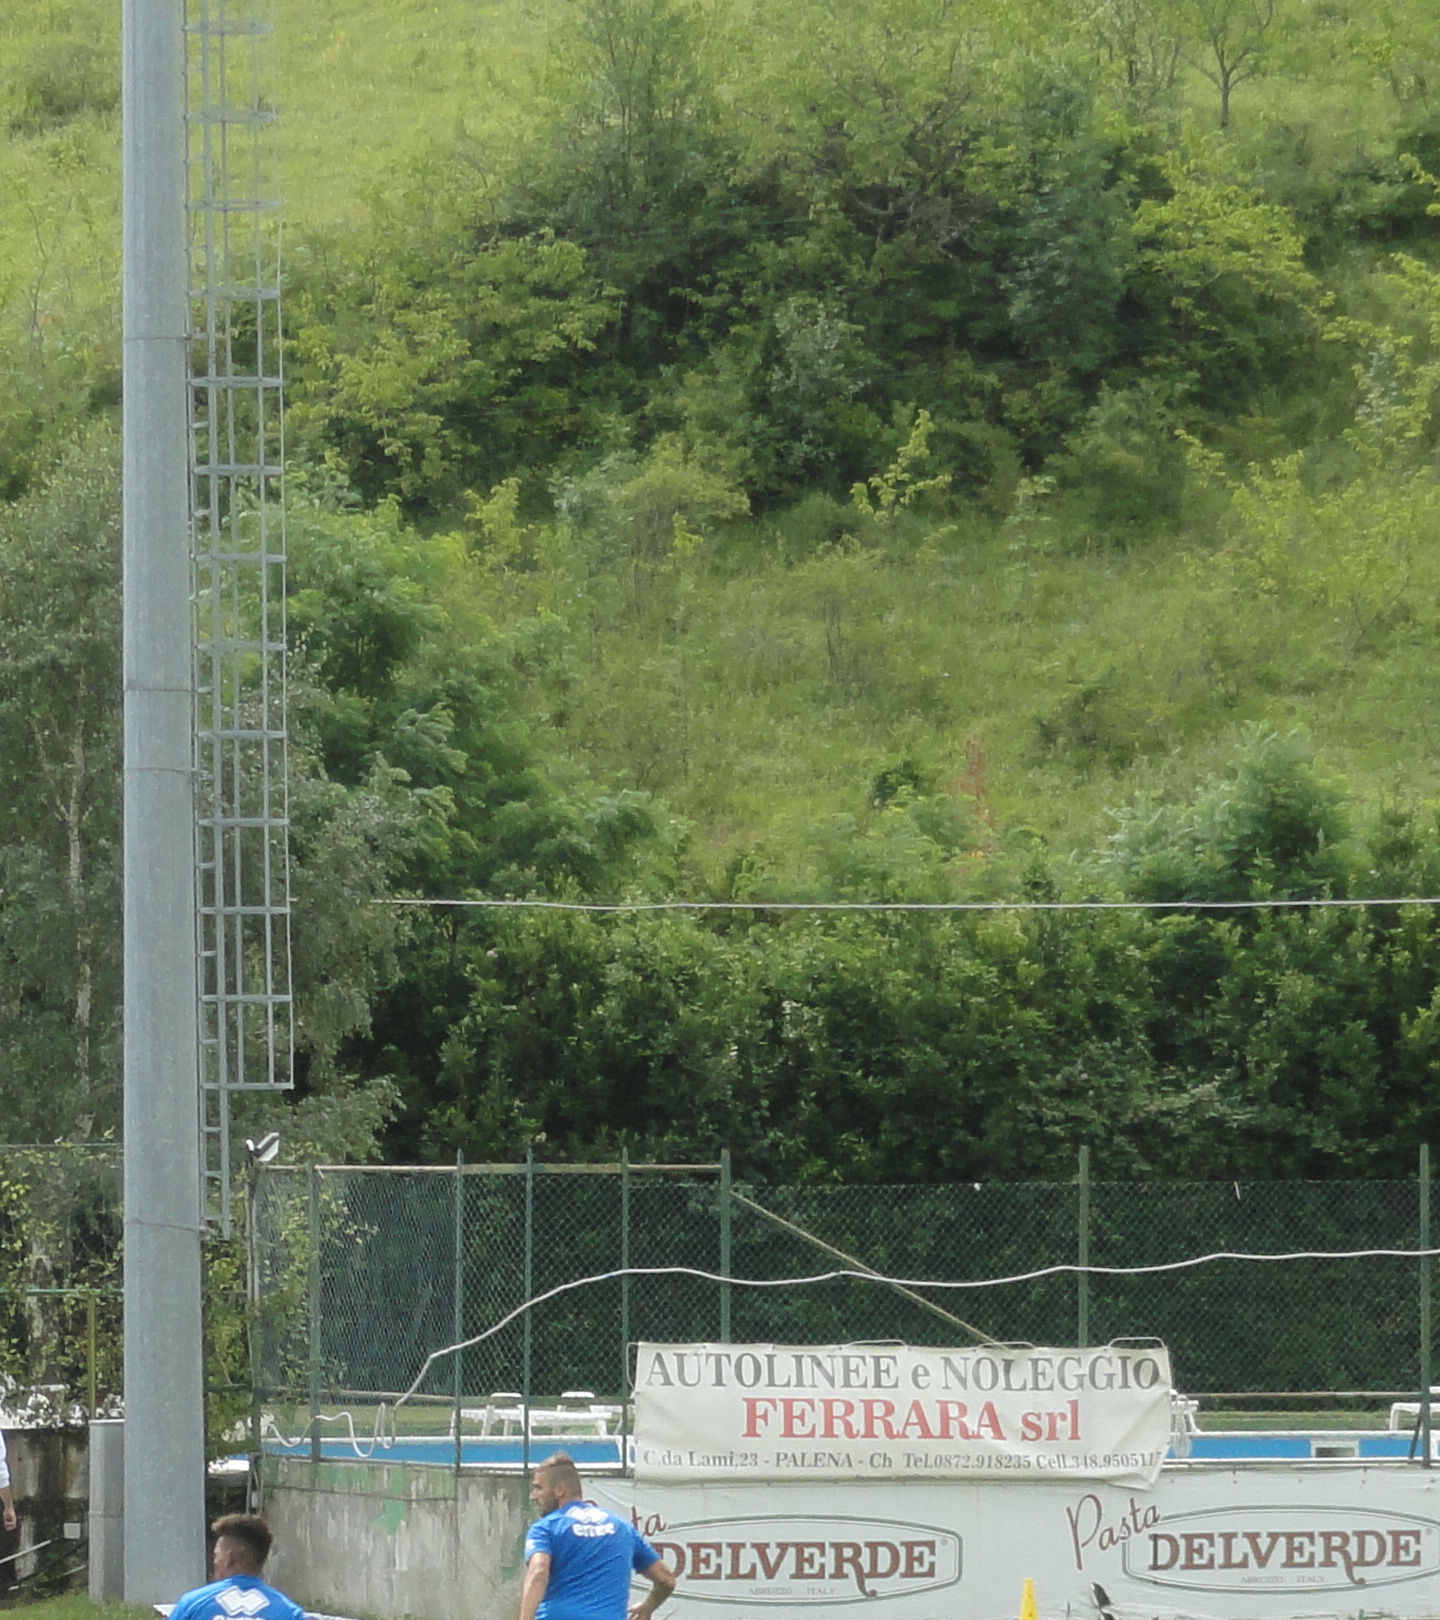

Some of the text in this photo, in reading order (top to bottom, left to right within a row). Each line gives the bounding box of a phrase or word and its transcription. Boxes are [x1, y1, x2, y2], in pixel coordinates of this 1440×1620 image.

[646, 1352, 1161, 1391] AUTOLINEE e NOLEGGIO
[741, 1397, 1082, 1442] FERRARA srl
[689, 1450, 759, 1469] Lami,23
[776, 1452, 853, 1469] PALENA
[869, 1452, 893, 1469] Ch
[1065, 1494, 1161, 1571] Pasta
[1148, 1529, 1421, 1585] DELVERDE
[651, 1540, 936, 1597] DELVERDE
